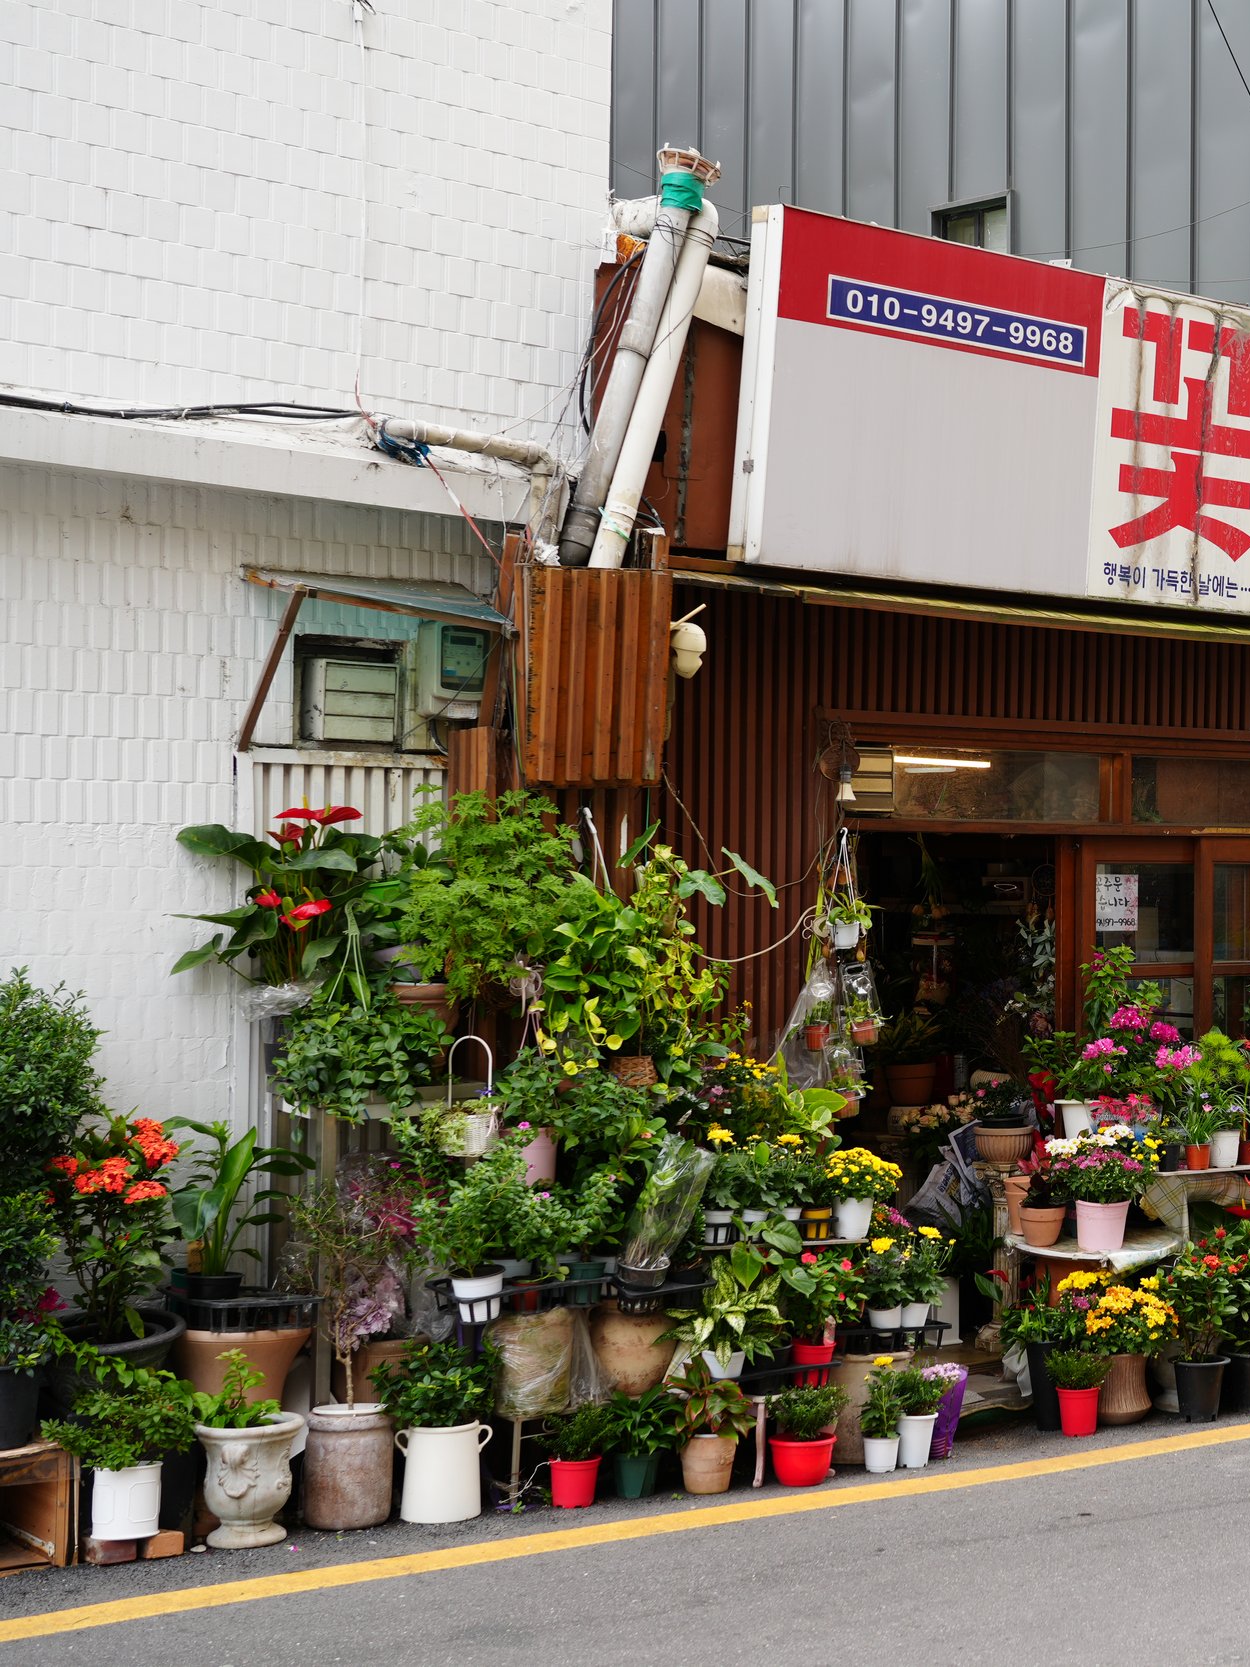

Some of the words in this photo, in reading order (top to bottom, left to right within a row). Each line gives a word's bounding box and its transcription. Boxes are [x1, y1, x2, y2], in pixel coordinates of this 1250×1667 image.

[846, 290, 1074, 354] 010-9497-9968
[1103, 562, 1146, 589] 행복이
[1152, 568, 1193, 594] 가득한
